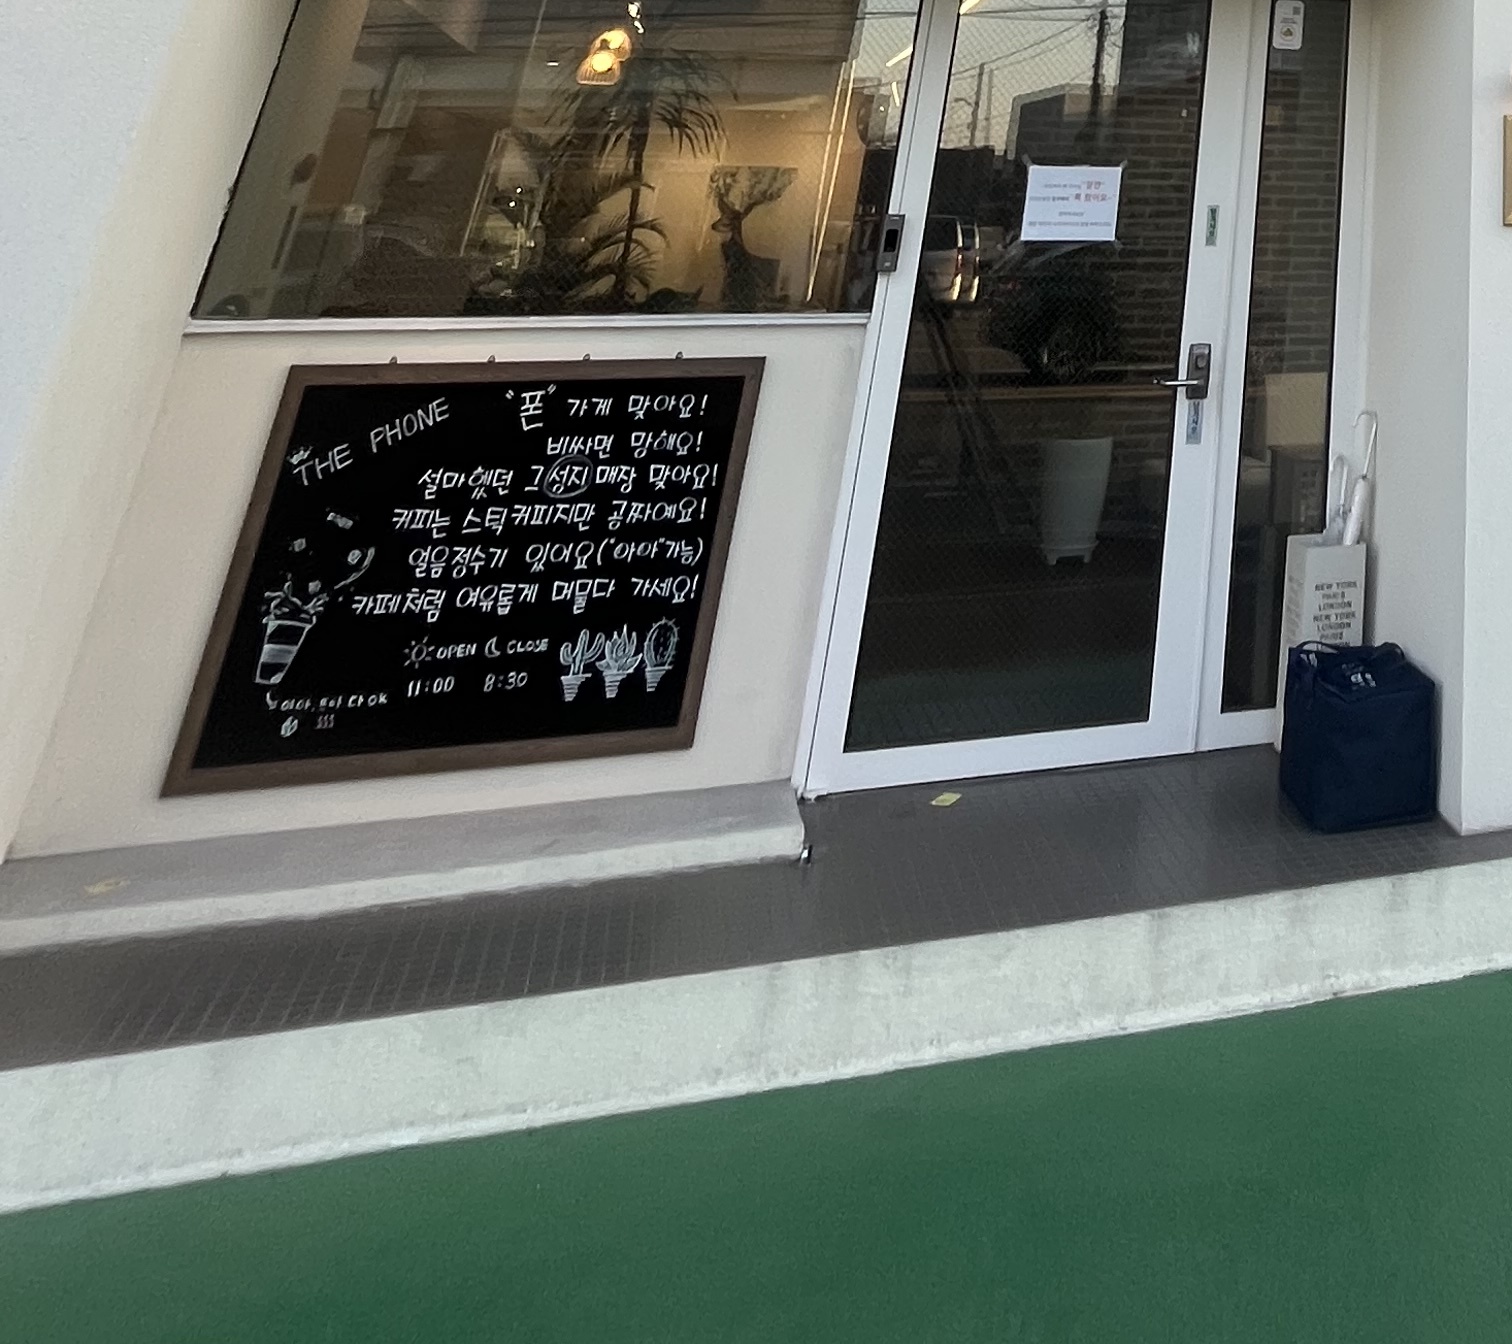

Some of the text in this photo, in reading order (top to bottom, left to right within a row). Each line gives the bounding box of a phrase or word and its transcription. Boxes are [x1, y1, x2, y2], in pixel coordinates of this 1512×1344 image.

[567, 397, 613, 417] 가게
[628, 394, 708, 419] 맞아요!
[293, 397, 449, 486] THE PHONE
[546, 430, 703, 459] 비싸면 망해요!
[595, 464, 636, 493] 매장
[649, 463, 719, 490] 맞아요!
[392, 508, 451, 539] 커피는
[607, 497, 706, 530] 공짜예요!
[351, 574, 700, 623] 카페처럼 여유롭게 머물다 가세요!
[1315, 583, 1333, 591] NEW
[436, 638, 550, 660] OPEN CLOSE
[407, 671, 529, 698] 11:00 8:30
